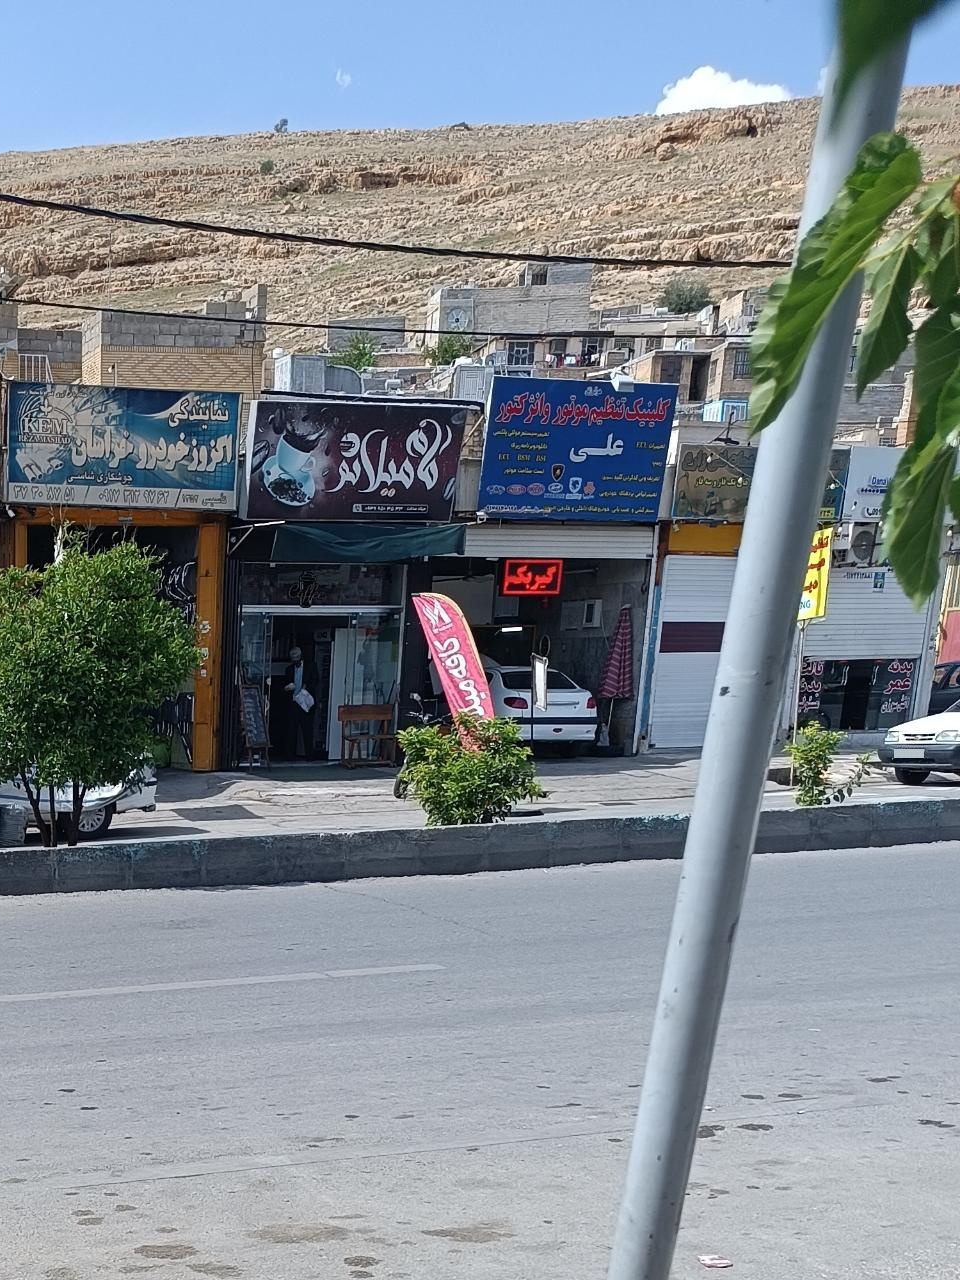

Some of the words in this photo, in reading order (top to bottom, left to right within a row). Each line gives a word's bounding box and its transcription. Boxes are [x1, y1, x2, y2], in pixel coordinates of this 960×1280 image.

[168, 400, 229, 430] نمایندگی
[552, 395, 590, 425] موتور
[589, 395, 627, 426] تنظیم
[625, 397, 671, 427] کلینیک
[24, 417, 68, 435] KEM
[72, 428, 134, 469] خراسان
[136, 432, 189, 470] خودرو
[569, 433, 624, 463] علی
[68, 471, 96, 482] شاسی
[96, 472, 133, 485] جوشکاری
[99, 488, 120, 504] ۰۹۱۷
[433, 637, 467, 678] کافه
